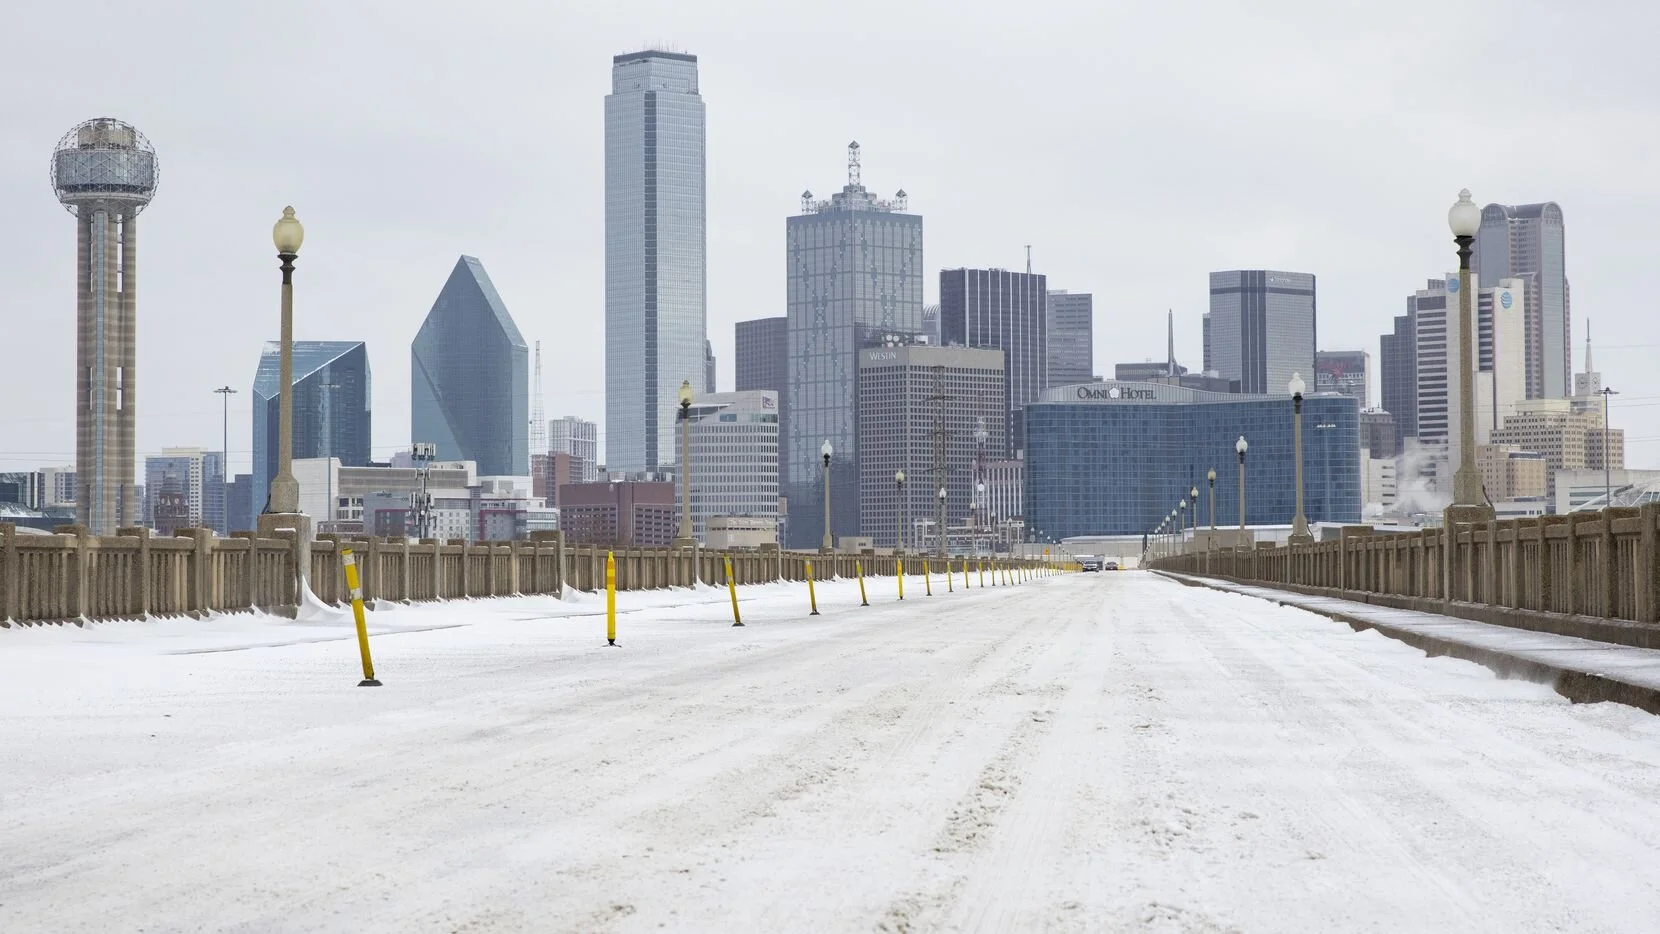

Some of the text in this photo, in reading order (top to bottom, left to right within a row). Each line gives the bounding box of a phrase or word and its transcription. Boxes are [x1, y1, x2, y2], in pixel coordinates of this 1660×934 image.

[869, 351, 897, 361] WESTIN
[1077, 386, 1157, 400] OMNI HOTEL
